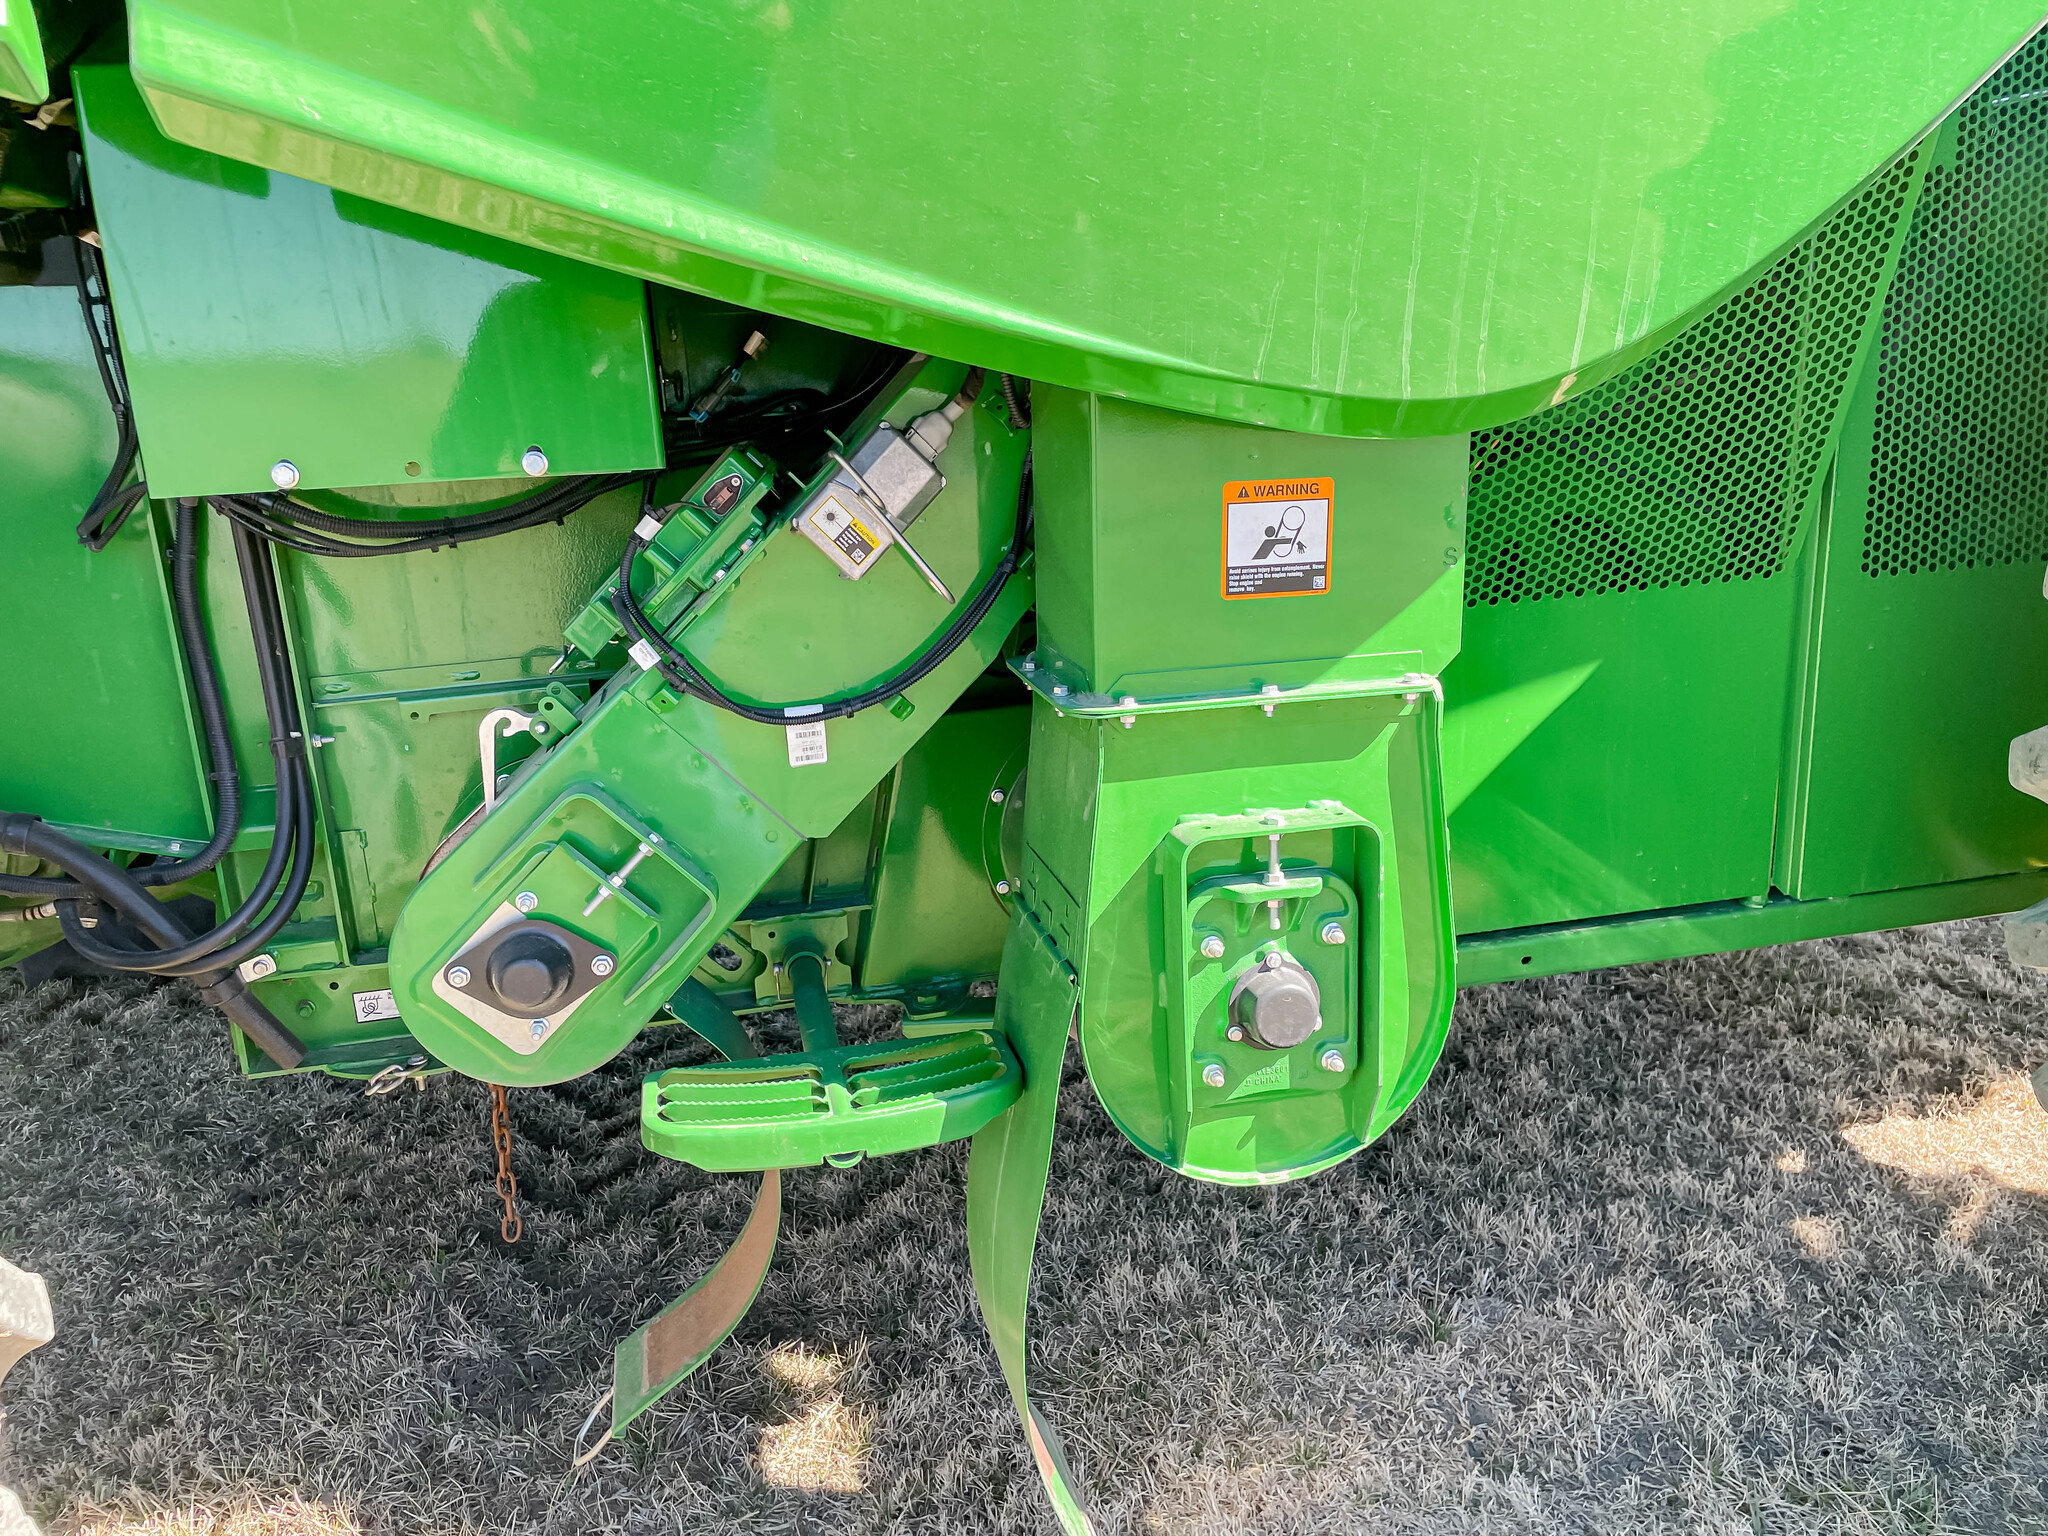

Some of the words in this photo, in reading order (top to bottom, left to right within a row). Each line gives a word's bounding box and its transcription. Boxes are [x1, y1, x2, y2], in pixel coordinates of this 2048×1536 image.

[1253, 483, 1319, 497] WARNING
[857, 526, 875, 544] CAUTION
[1443, 547, 1457, 567] S
[1258, 566, 1270, 574] injury
[1255, 1075, 1281, 1086] CHINA
